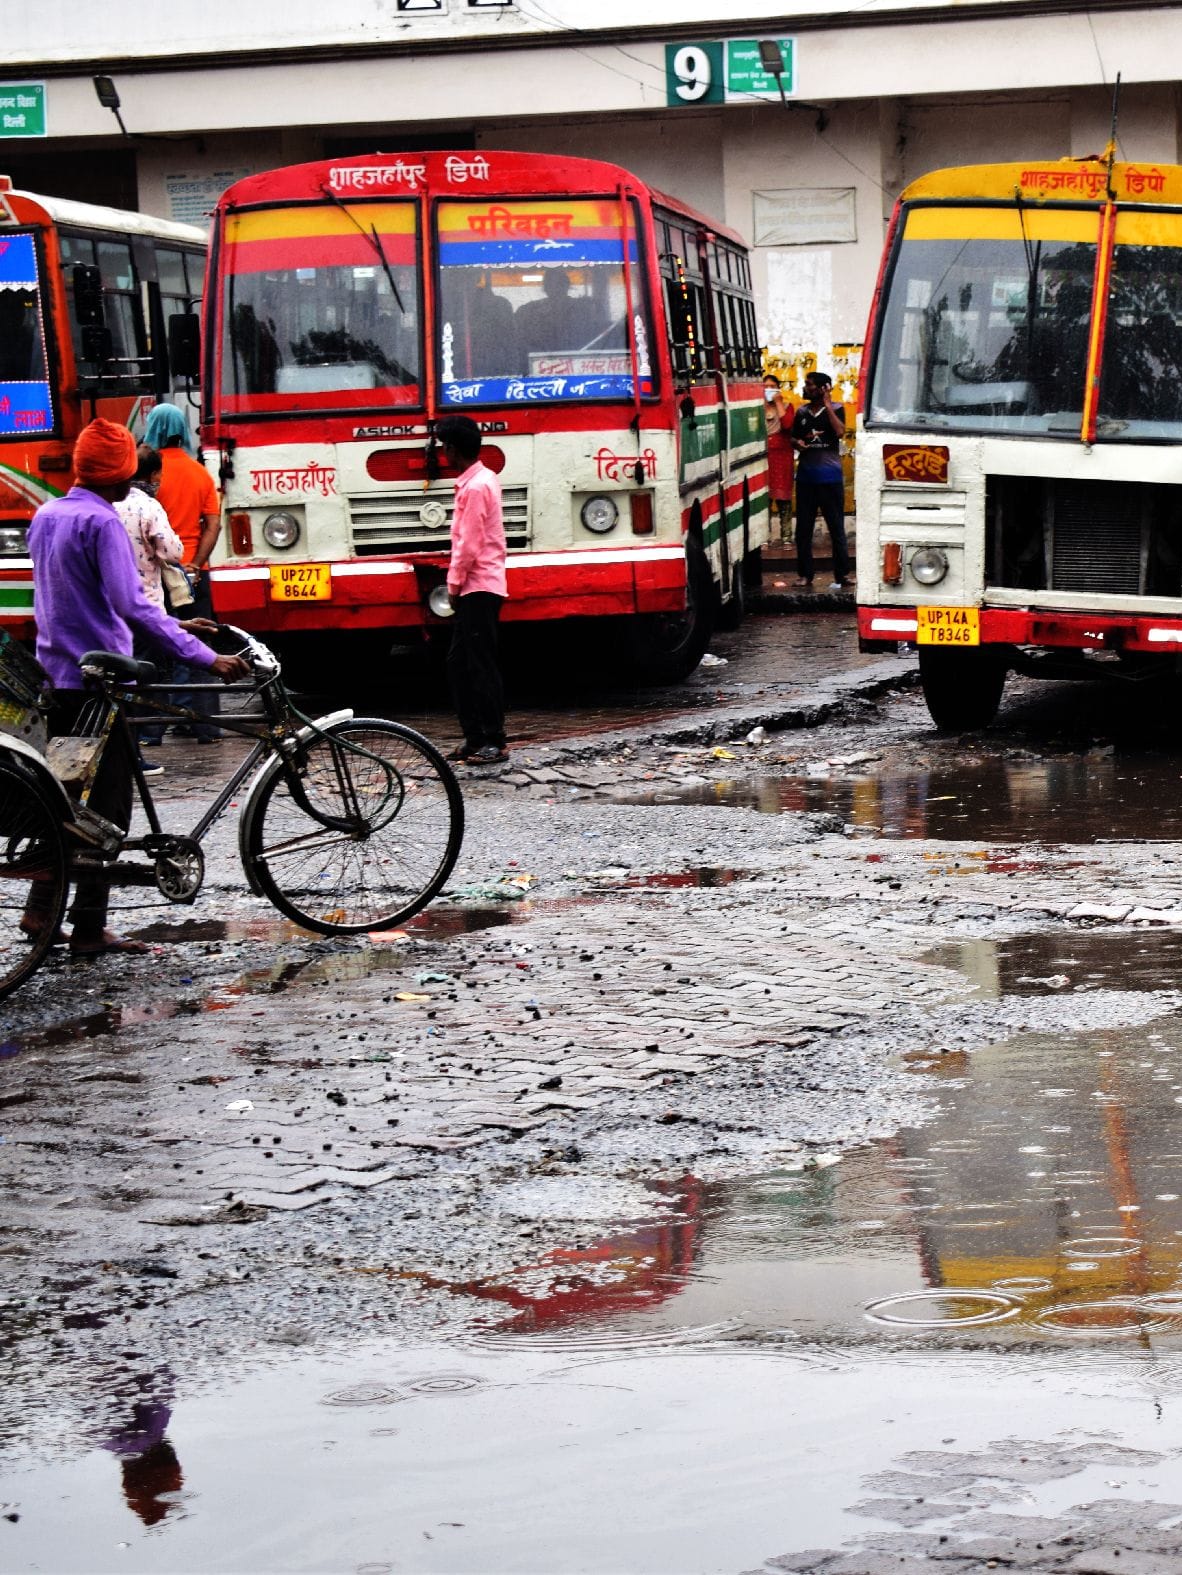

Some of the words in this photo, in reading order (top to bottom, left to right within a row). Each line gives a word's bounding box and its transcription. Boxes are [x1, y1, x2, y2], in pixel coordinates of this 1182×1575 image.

[673, 46, 711, 100] 9
[329, 159, 427, 191] शाहजहाँपुर
[444, 155, 490, 183] डिपो
[1020, 165, 1110, 199] शाहजहाँपुर
[1125, 167, 1166, 194] डिपो
[467, 206, 575, 238] परिवहन
[506, 378, 567, 400] दिल्ली
[14, 410, 47, 428] लाभ
[356, 425, 415, 437] ASHOK
[593, 447, 658, 483] दिल्ली
[250, 460, 337, 496] शाहजहाँपुर
[281, 568, 322, 581] UP27T
[284, 585, 317, 598] 8644
[927, 610, 968, 625] UP14A
[930, 628, 970, 642] T8346
